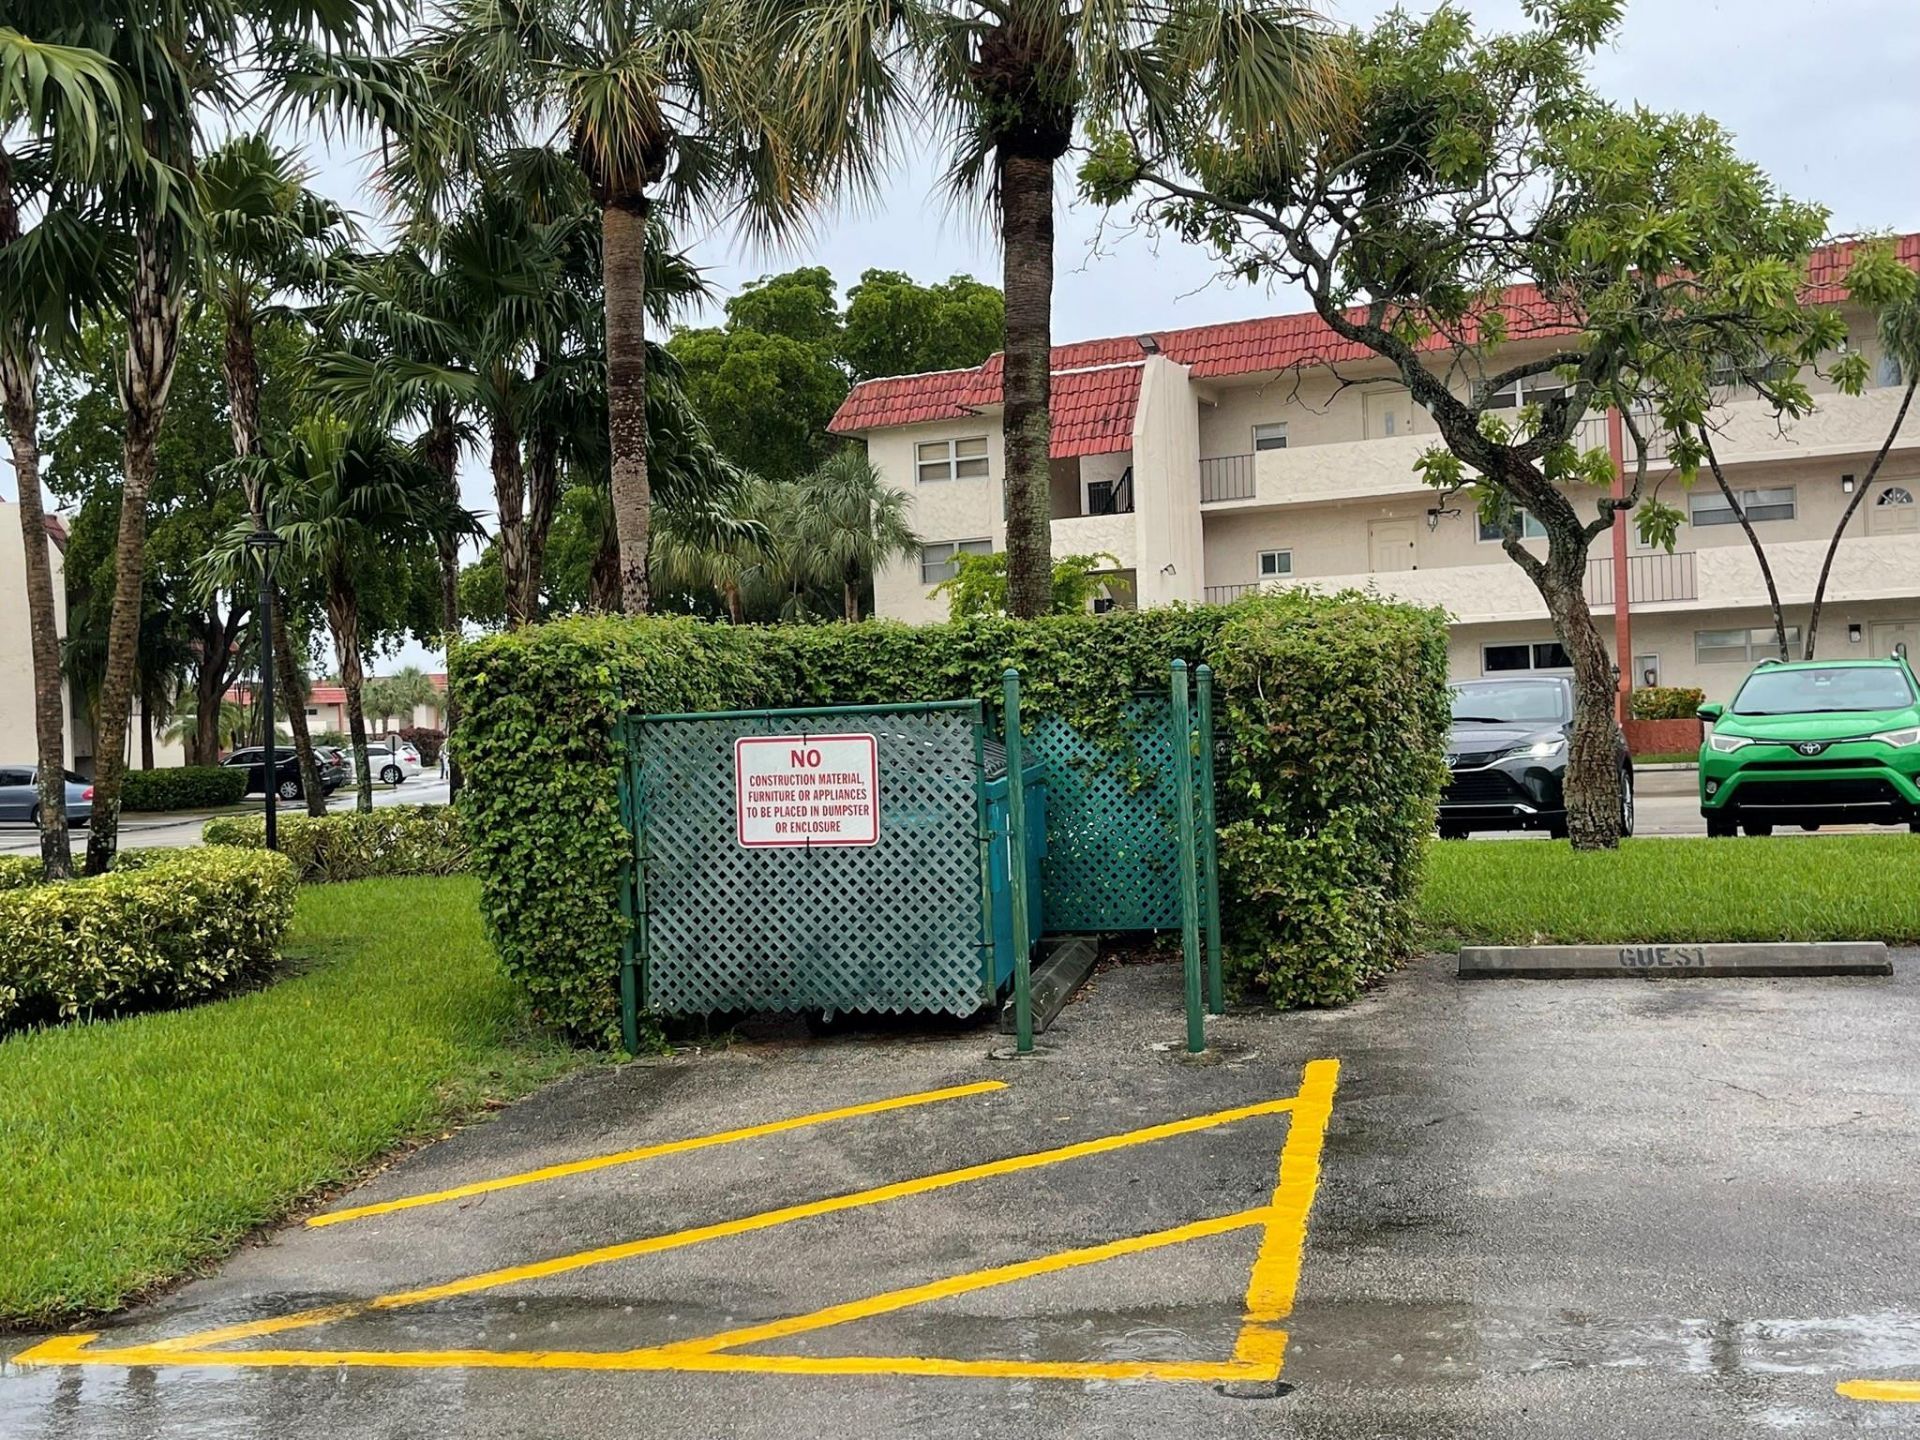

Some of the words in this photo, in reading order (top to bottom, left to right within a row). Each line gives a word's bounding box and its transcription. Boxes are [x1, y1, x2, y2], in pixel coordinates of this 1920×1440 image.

[791, 749, 821, 768] NO
[749, 774, 815, 787] CONSTRUCTION
[819, 773, 864, 786] MATERIAL,
[748, 791, 796, 802] FURNITURE
[799, 790, 810, 801] OR
[814, 789, 867, 800] APPLIANCES
[746, 807, 757, 818] TO
[761, 807, 771, 817] BE
[774, 806, 807, 817] PLACED
[811, 806, 819, 816] IN
[823, 805, 869, 816] DUMPSTER
[776, 822, 787, 833] OR
[791, 821, 841, 833] ENCLOSURE
